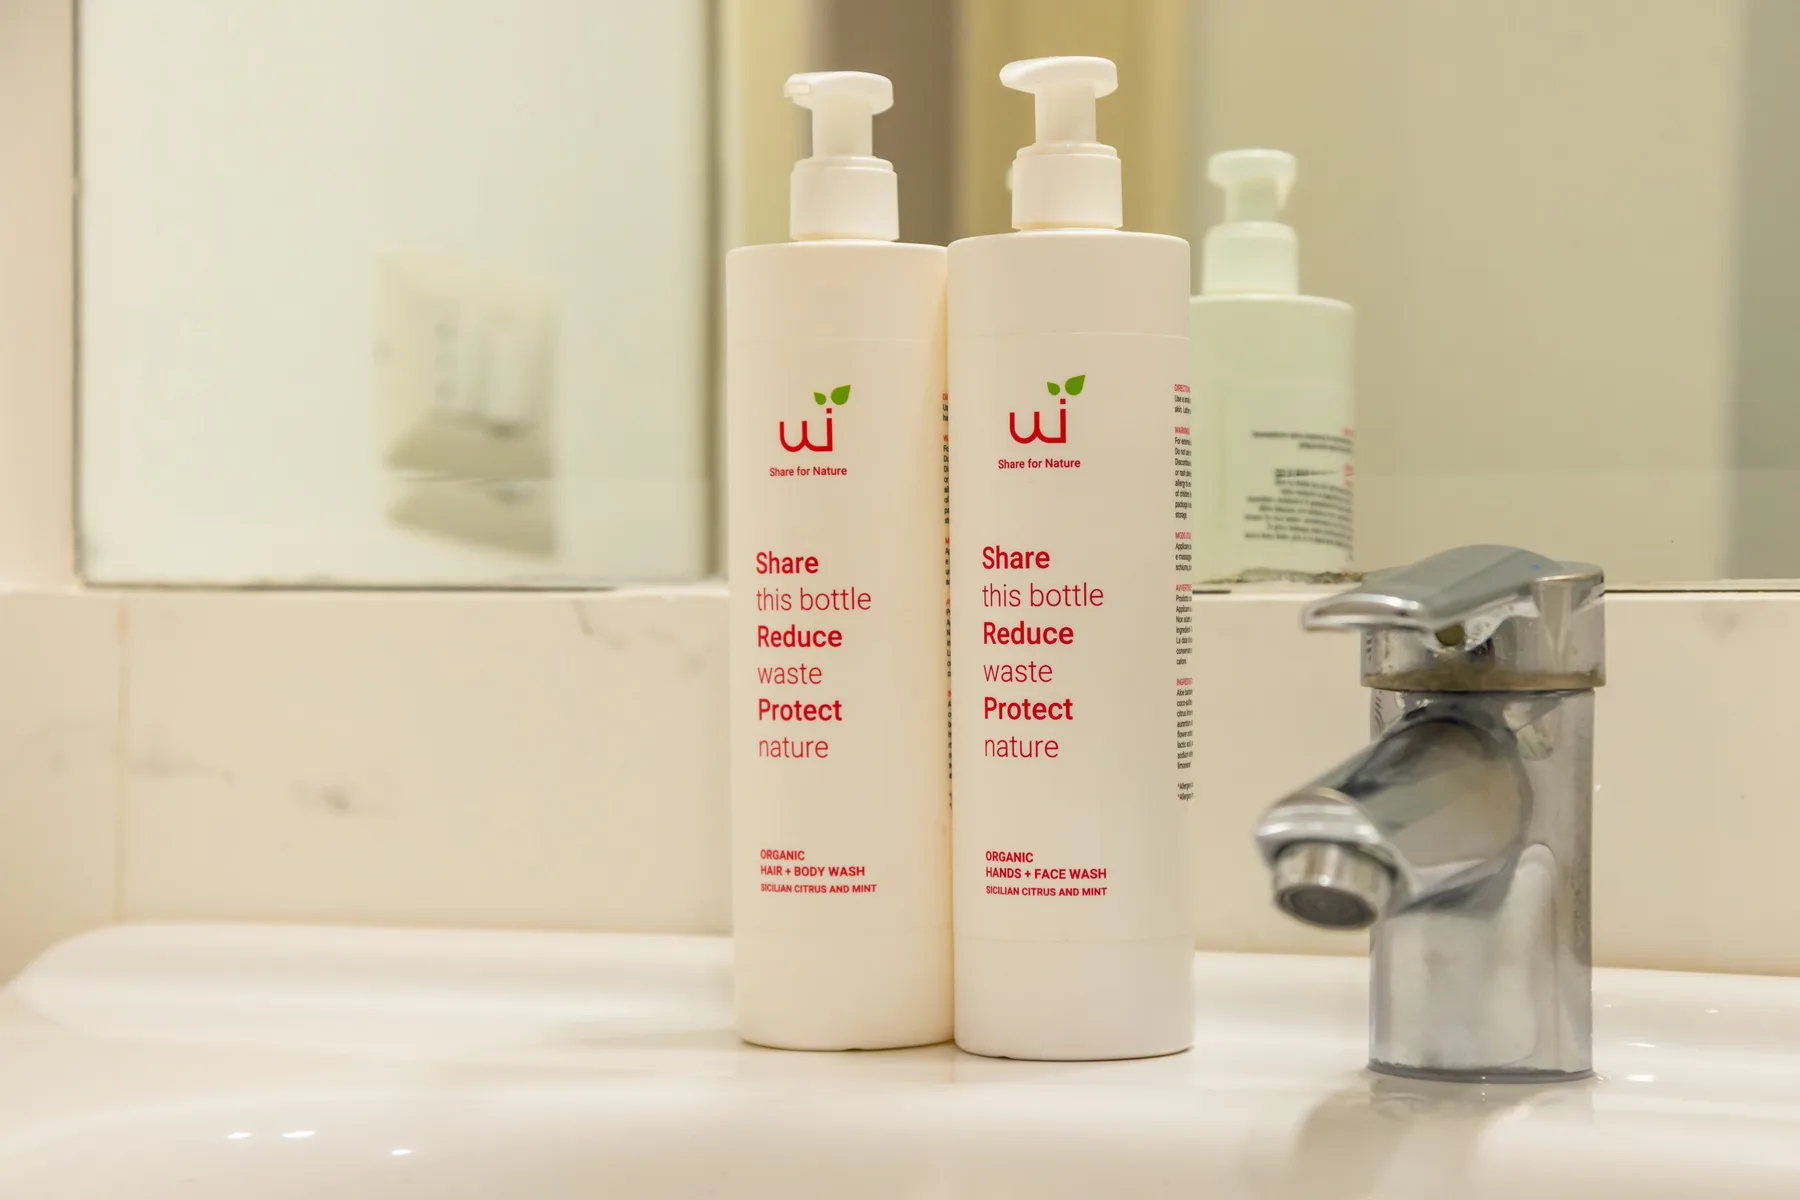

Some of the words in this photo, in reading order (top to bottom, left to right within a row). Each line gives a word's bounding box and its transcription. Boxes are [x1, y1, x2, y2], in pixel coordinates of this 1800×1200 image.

[769, 466, 795, 477] Share
[796, 466, 811, 477] for
[812, 466, 848, 477] Nature
[997, 458, 1026, 469] Share
[1027, 458, 1043, 469] for
[1044, 457, 1081, 469] Nature
[756, 551, 820, 575] Share
[982, 545, 1051, 570] Share
[756, 588, 792, 612] this
[800, 587, 872, 612] bottle
[982, 583, 1021, 608] this
[1029, 582, 1104, 608] bottle
[757, 624, 843, 649] Reduce
[983, 620, 1075, 645] Reduce
[757, 663, 823, 685] waste
[983, 660, 1053, 683] waste
[758, 698, 843, 722] Protect
[984, 696, 1074, 721] Protect
[758, 736, 829, 759] nature
[984, 735, 1060, 759] nature
[760, 849, 806, 862] ORGANIC
[985, 850, 1034, 863] ORGANIC
[760, 864, 783, 877] HAIR
[785, 867, 792, 876] +
[793, 865, 826, 878] BODY
[828, 865, 866, 877] WASH
[985, 866, 1022, 880] HANDS
[1024, 869, 1032, 879] +
[1034, 867, 1067, 880] FACE
[1069, 867, 1107, 880] WASH
[760, 882, 793, 893] SICILIAN
[794, 883, 828, 894] CITRUS
[829, 883, 851, 894] AND
[851, 883, 878, 893] MINT
[985, 885, 1020, 896] SICILIAN
[1021, 886, 1057, 897] CITRUS
[1058, 886, 1080, 897] AND
[1081, 886, 1108, 896] MINT
